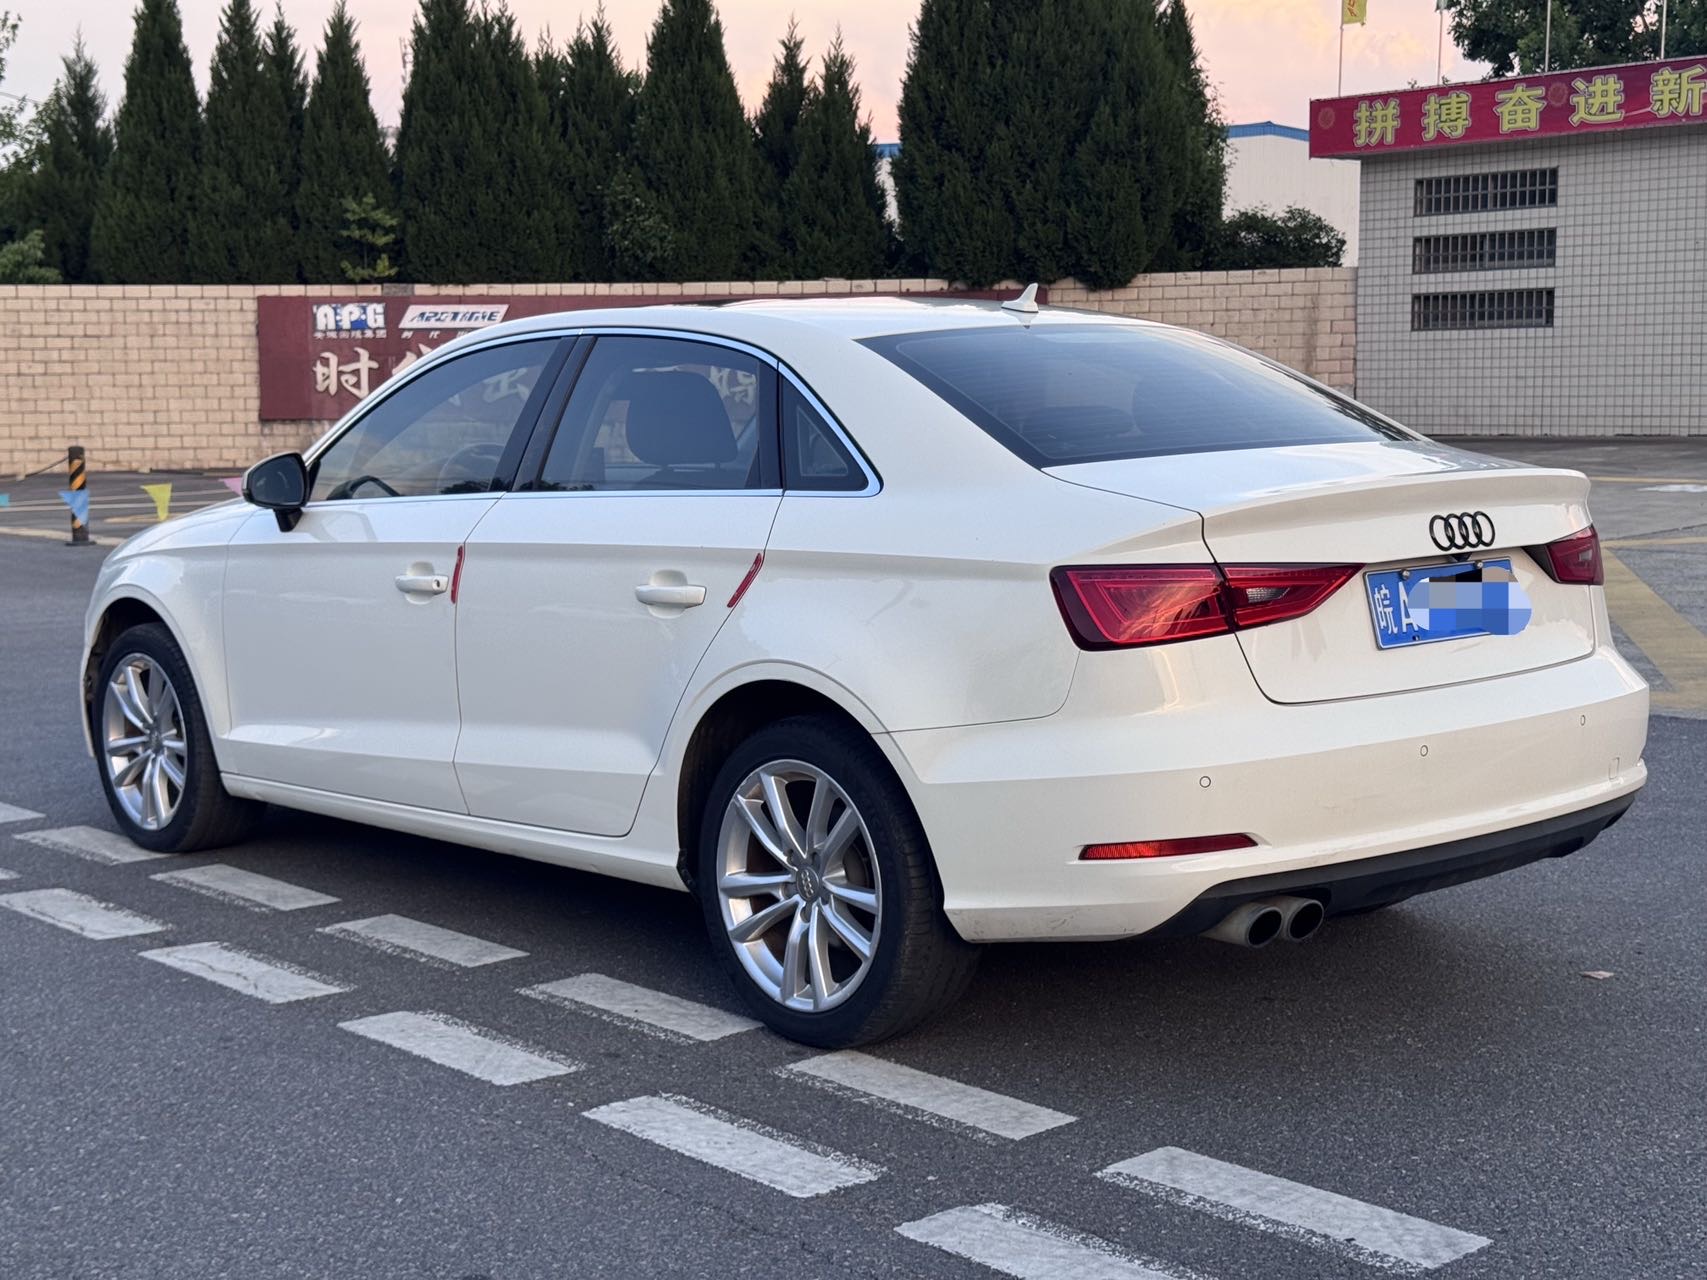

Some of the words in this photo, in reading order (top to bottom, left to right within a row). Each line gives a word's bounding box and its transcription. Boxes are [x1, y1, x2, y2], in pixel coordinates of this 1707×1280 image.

[1353, 65, 1706, 147] 拼搏奋进新
[313, 303, 385, 330] APG
